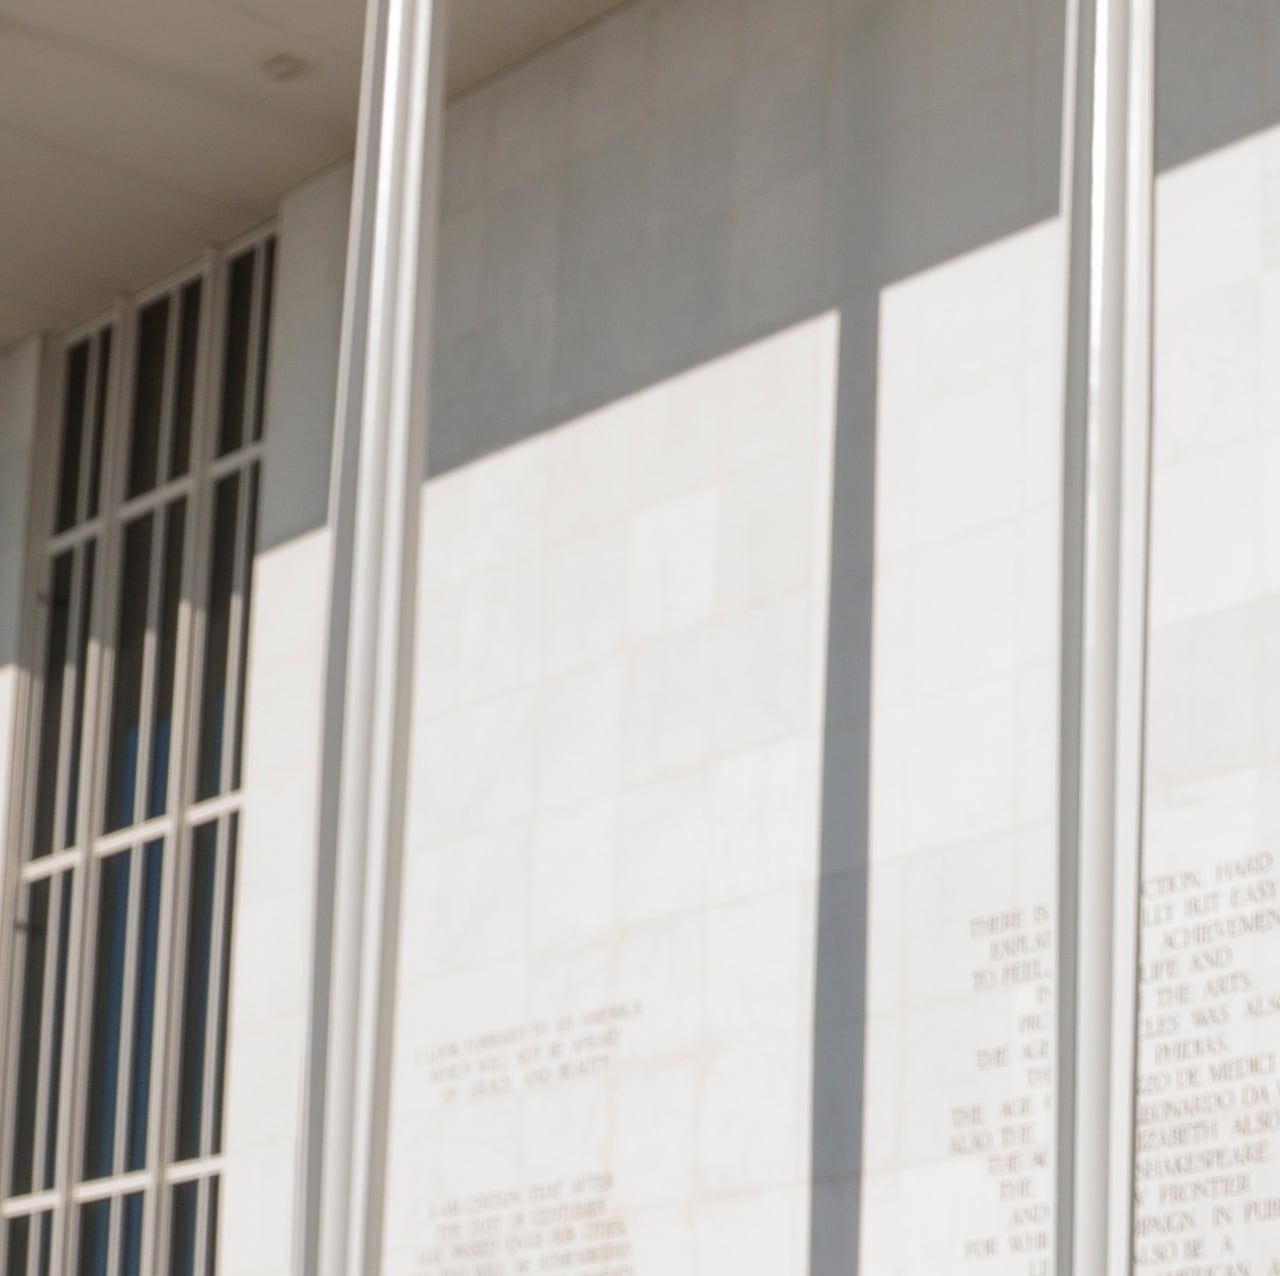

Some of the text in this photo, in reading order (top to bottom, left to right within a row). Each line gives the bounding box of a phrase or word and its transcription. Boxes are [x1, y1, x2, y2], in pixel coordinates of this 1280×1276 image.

[1215, 849, 1274, 883] HARD
[1184, 891, 1219, 918] BUT
[1230, 878, 1278, 909] EASY
[1190, 945, 1233, 974] AND
[1156, 982, 1191, 1009] THE
[1190, 1003, 1230, 1027] WAS
[1176, 1065, 1201, 1089] DE
[1208, 1051, 1277, 1083] MEDICI
[1241, 1084, 1270, 1108] DA
[1159, 1173, 1250, 1205] FRONTIER
[1212, 1204, 1233, 1226] IN
[1184, 1236, 1205, 1260] BE
[1220, 1234, 1234, 1254] A
